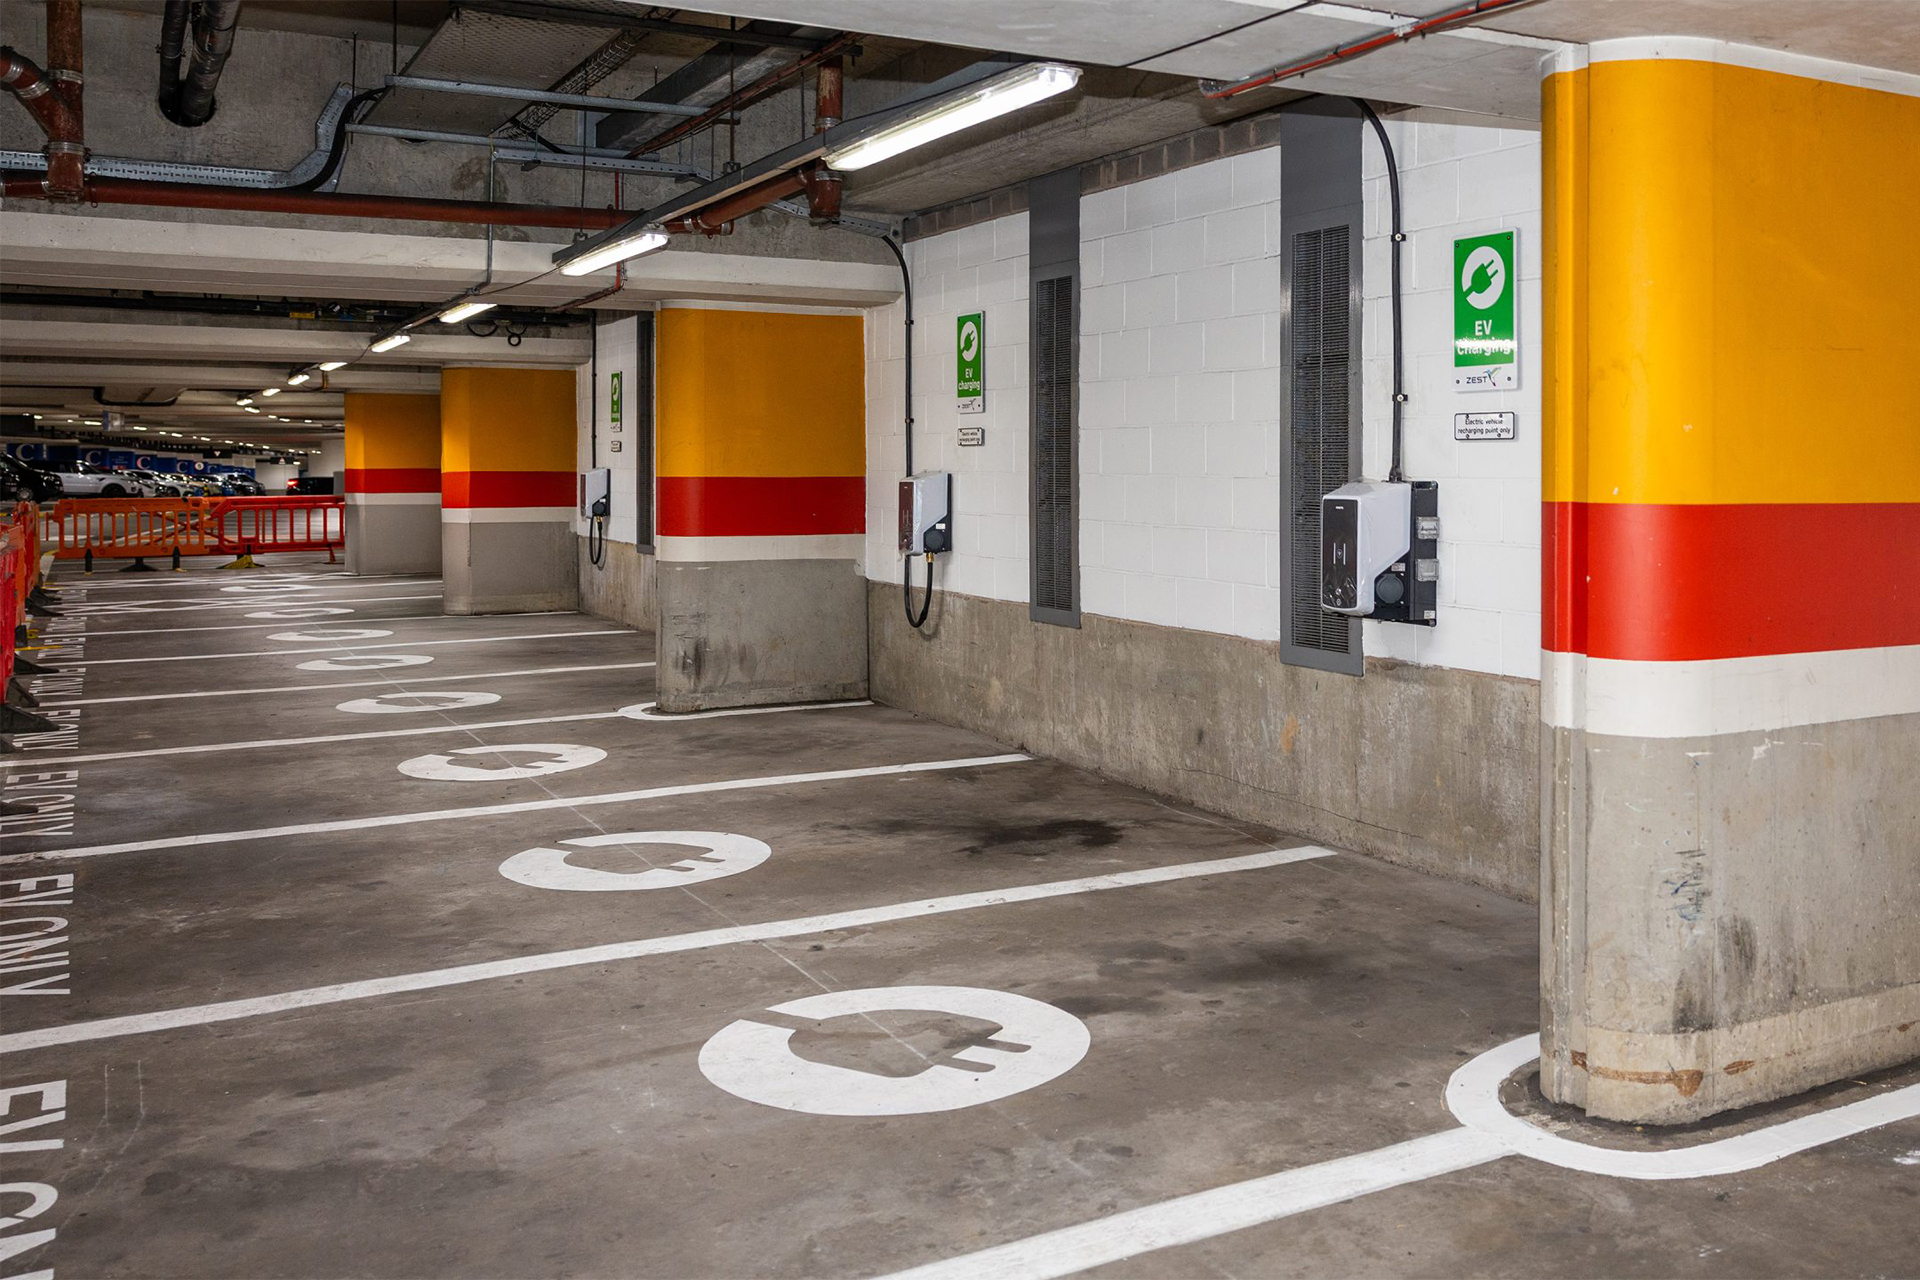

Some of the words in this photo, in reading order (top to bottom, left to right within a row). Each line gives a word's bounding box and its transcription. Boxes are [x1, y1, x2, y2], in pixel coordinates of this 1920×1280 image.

[1475, 319, 1492, 336] EV
[965, 368, 973, 378] EV
[1466, 376, 1487, 384] ZEST
[1457, 427, 1484, 435] recharging
[1499, 426, 1511, 434] only
[4, 770, 79, 790] EV
[0, 873, 74, 906] EV
